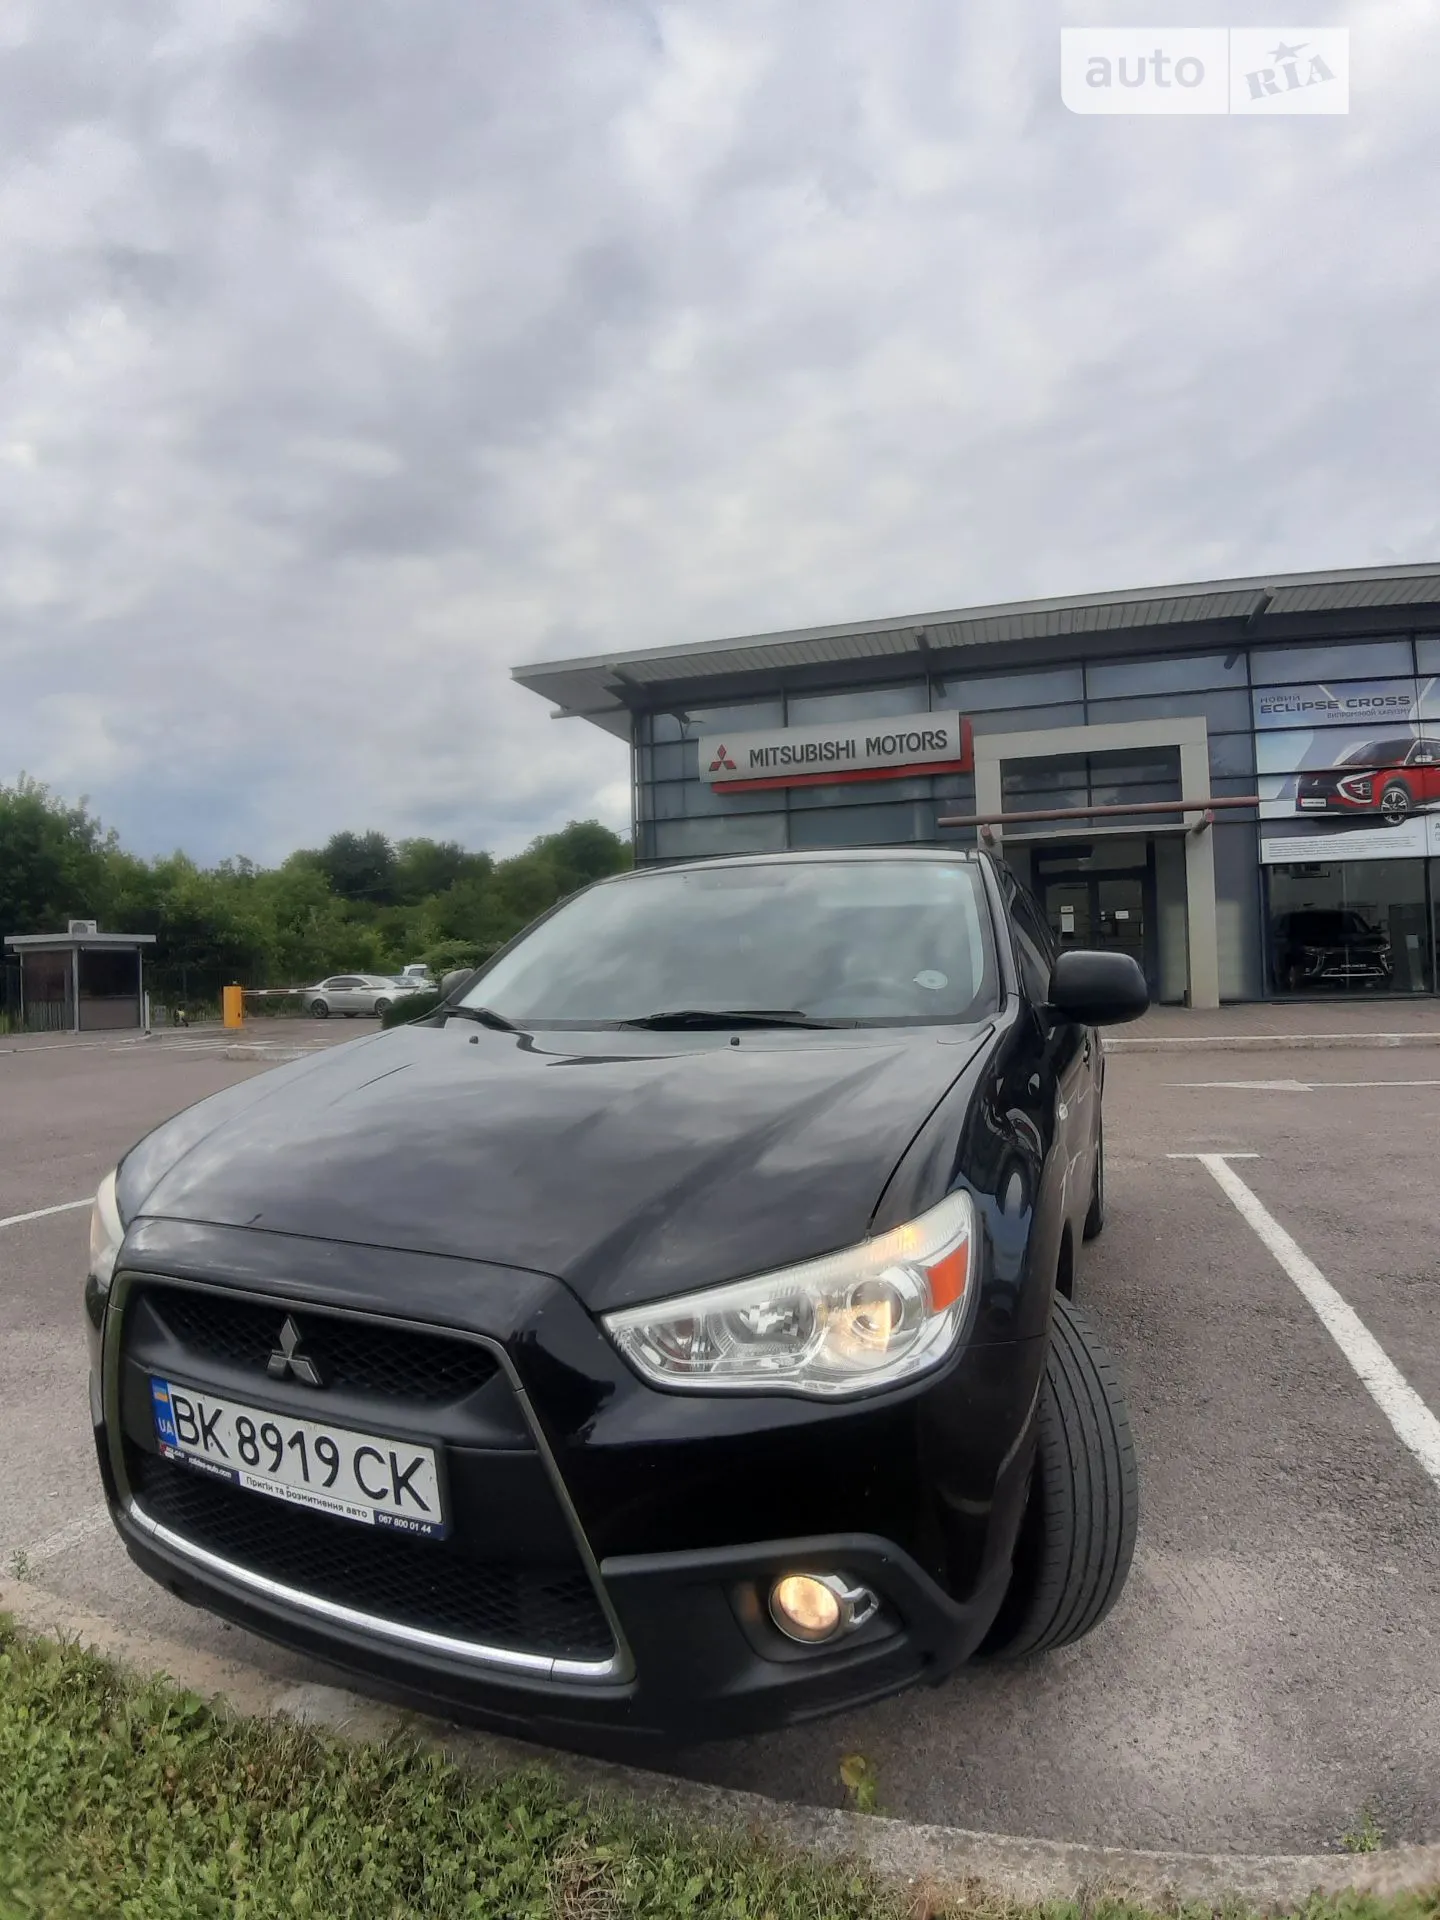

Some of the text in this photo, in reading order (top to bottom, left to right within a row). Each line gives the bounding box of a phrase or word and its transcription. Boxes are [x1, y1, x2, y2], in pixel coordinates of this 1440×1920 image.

[1260, 695, 1411, 714] ECLIPSE CROSS
[749, 729, 948, 768] MITSUBISHI MOTORS
[157, 1416, 175, 1437] UA
[171, 1393, 432, 1512] BK 8919 CK
[275, 1486, 285, 1496] та
[346, 1506, 368, 1518] авто
[378, 1514, 432, 1534] 067 800 01 44
